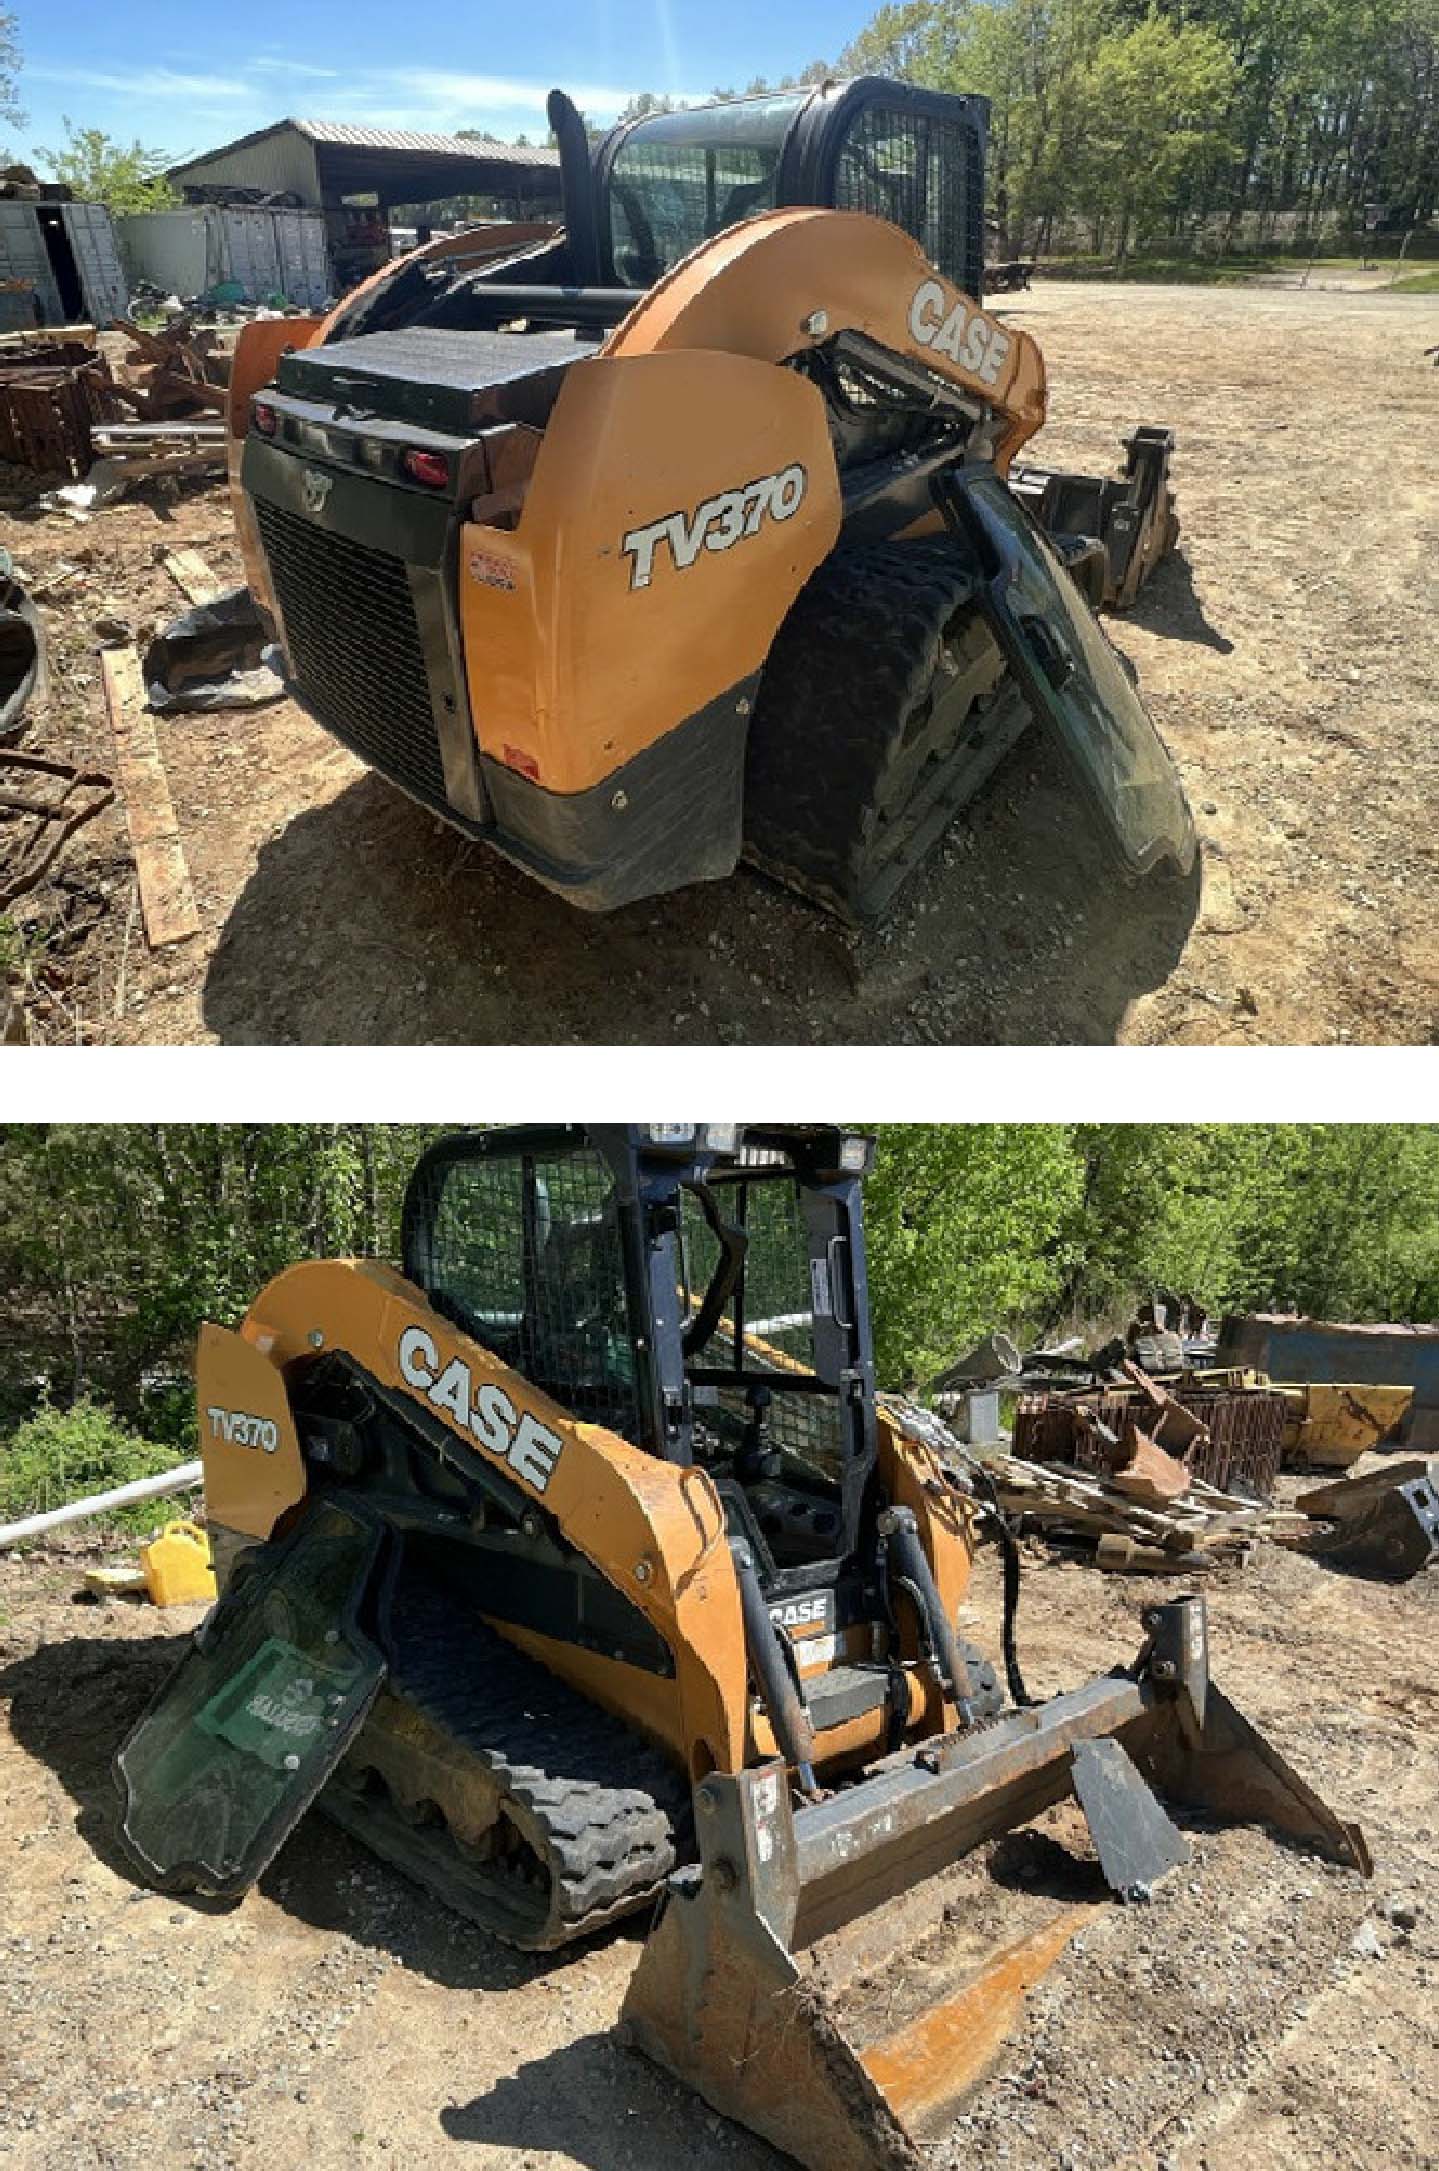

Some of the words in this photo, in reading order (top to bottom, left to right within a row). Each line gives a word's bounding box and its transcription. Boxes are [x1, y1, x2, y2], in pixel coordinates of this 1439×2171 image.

[909, 279, 1010, 384] CASE
[621, 463, 806, 589] TV370
[206, 1406, 279, 1453] TV370
[400, 1325, 563, 1493] CASE
[769, 1597, 827, 1626] CASE
